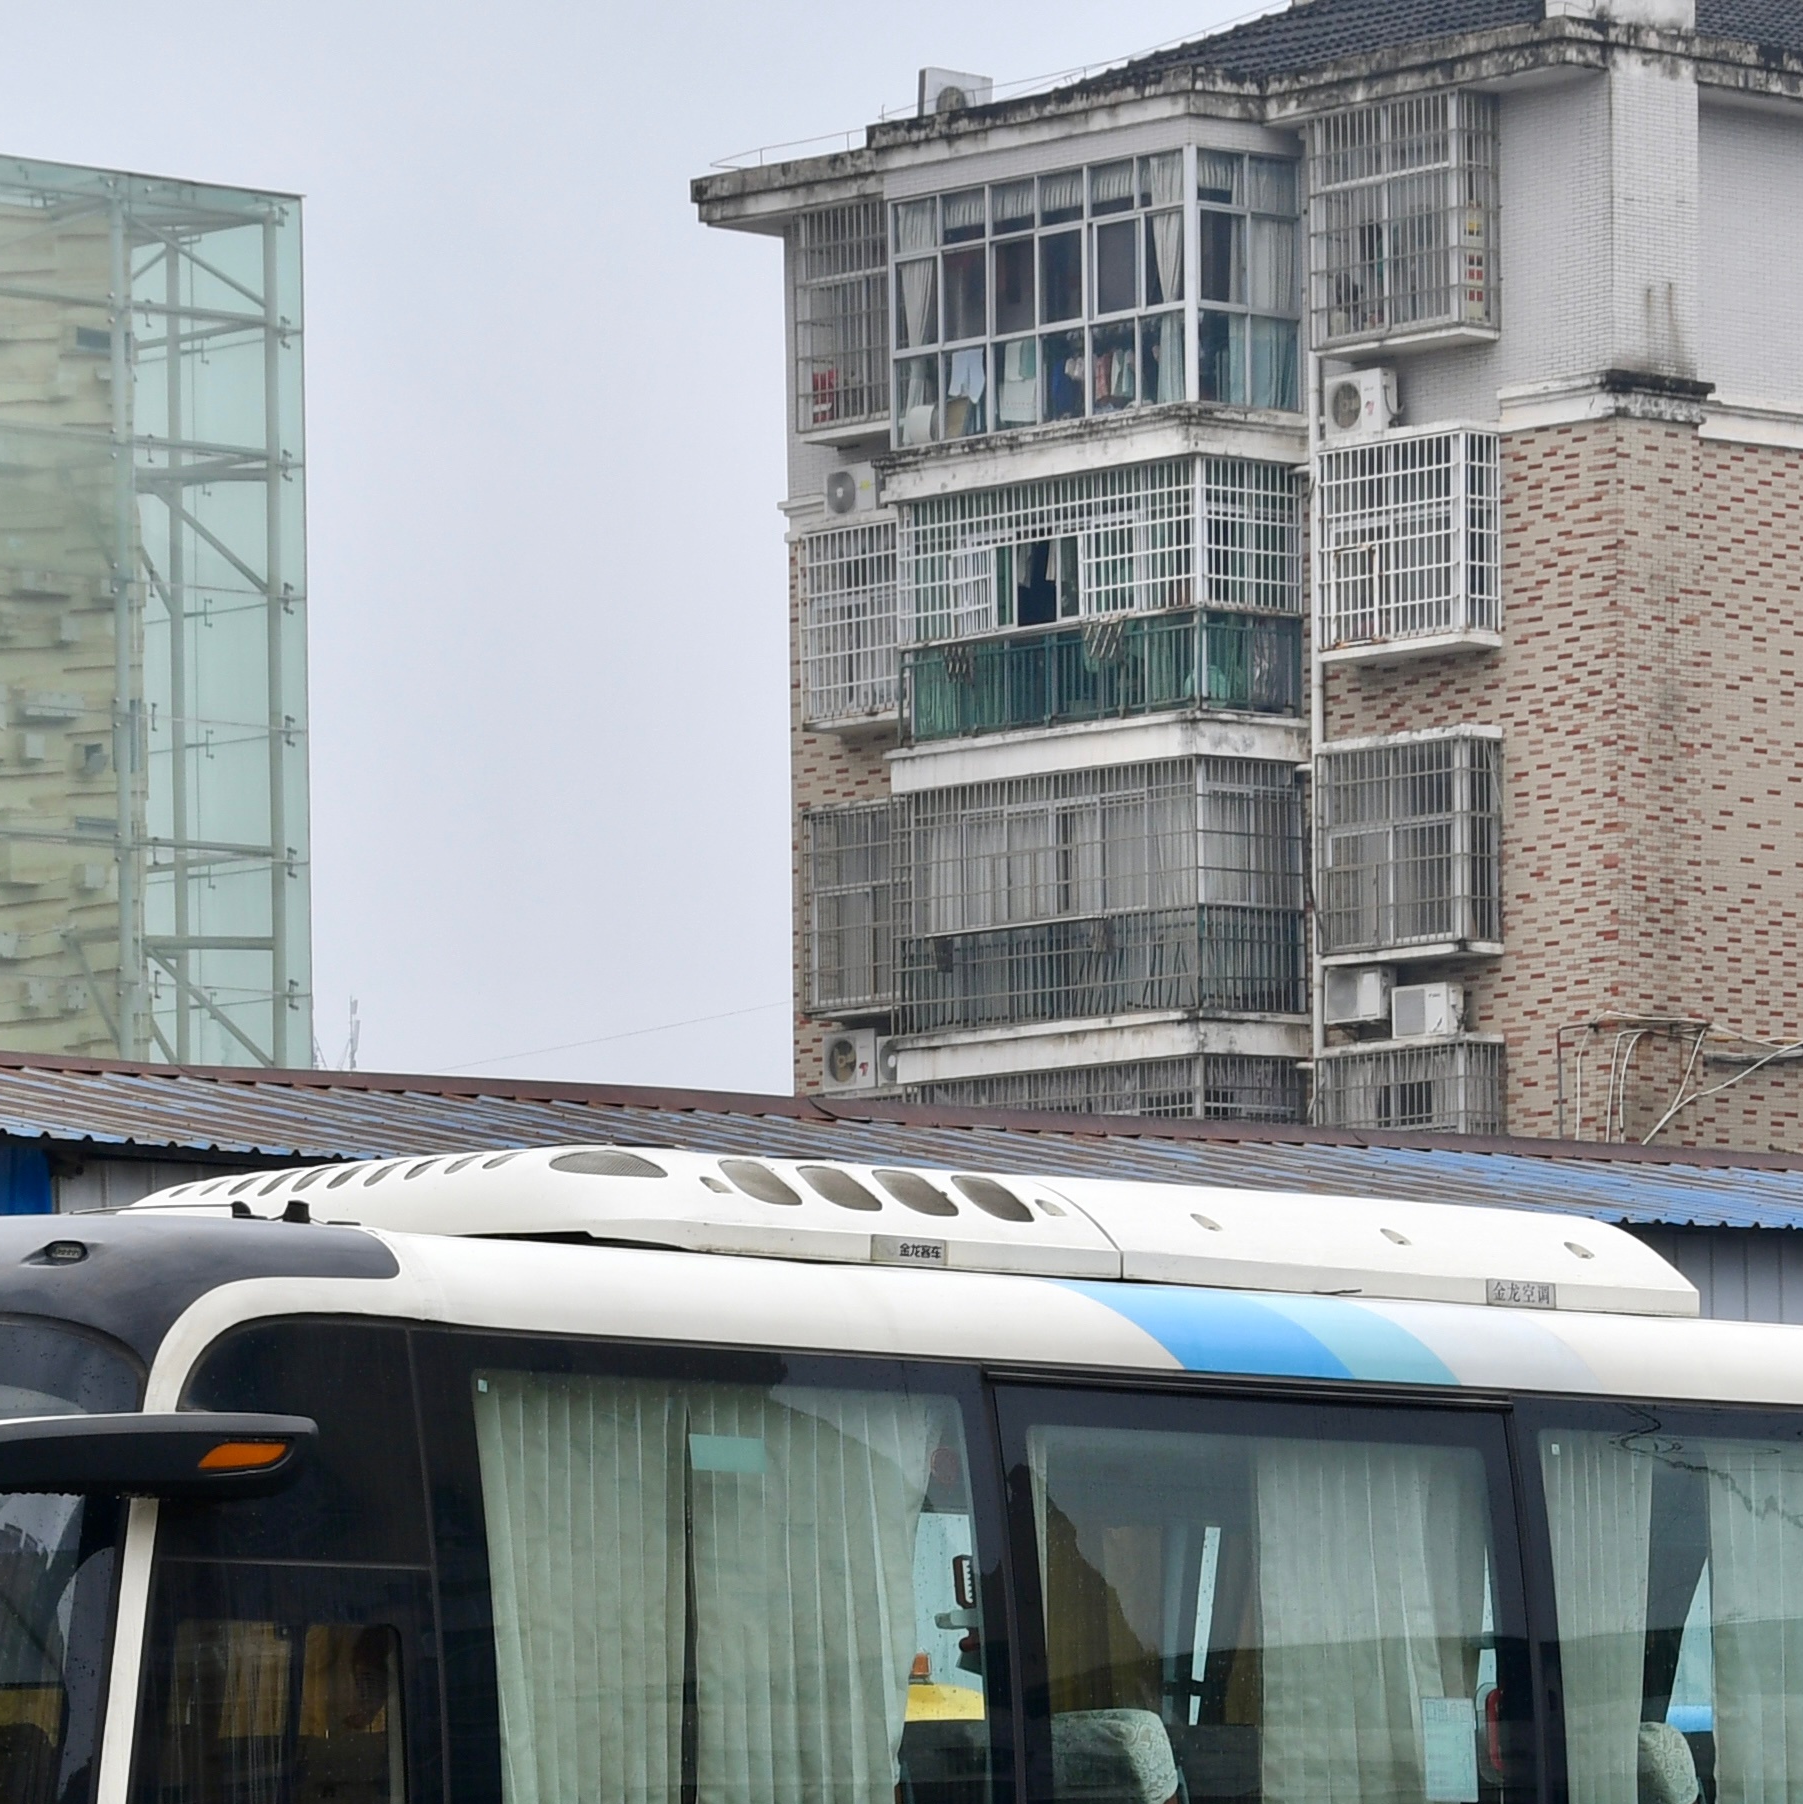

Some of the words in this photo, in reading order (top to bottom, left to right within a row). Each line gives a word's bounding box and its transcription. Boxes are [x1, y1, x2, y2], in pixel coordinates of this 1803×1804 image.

[899, 1242, 942, 1260] 金龙客车
[1493, 1281, 1550, 1305] 金龙空调
